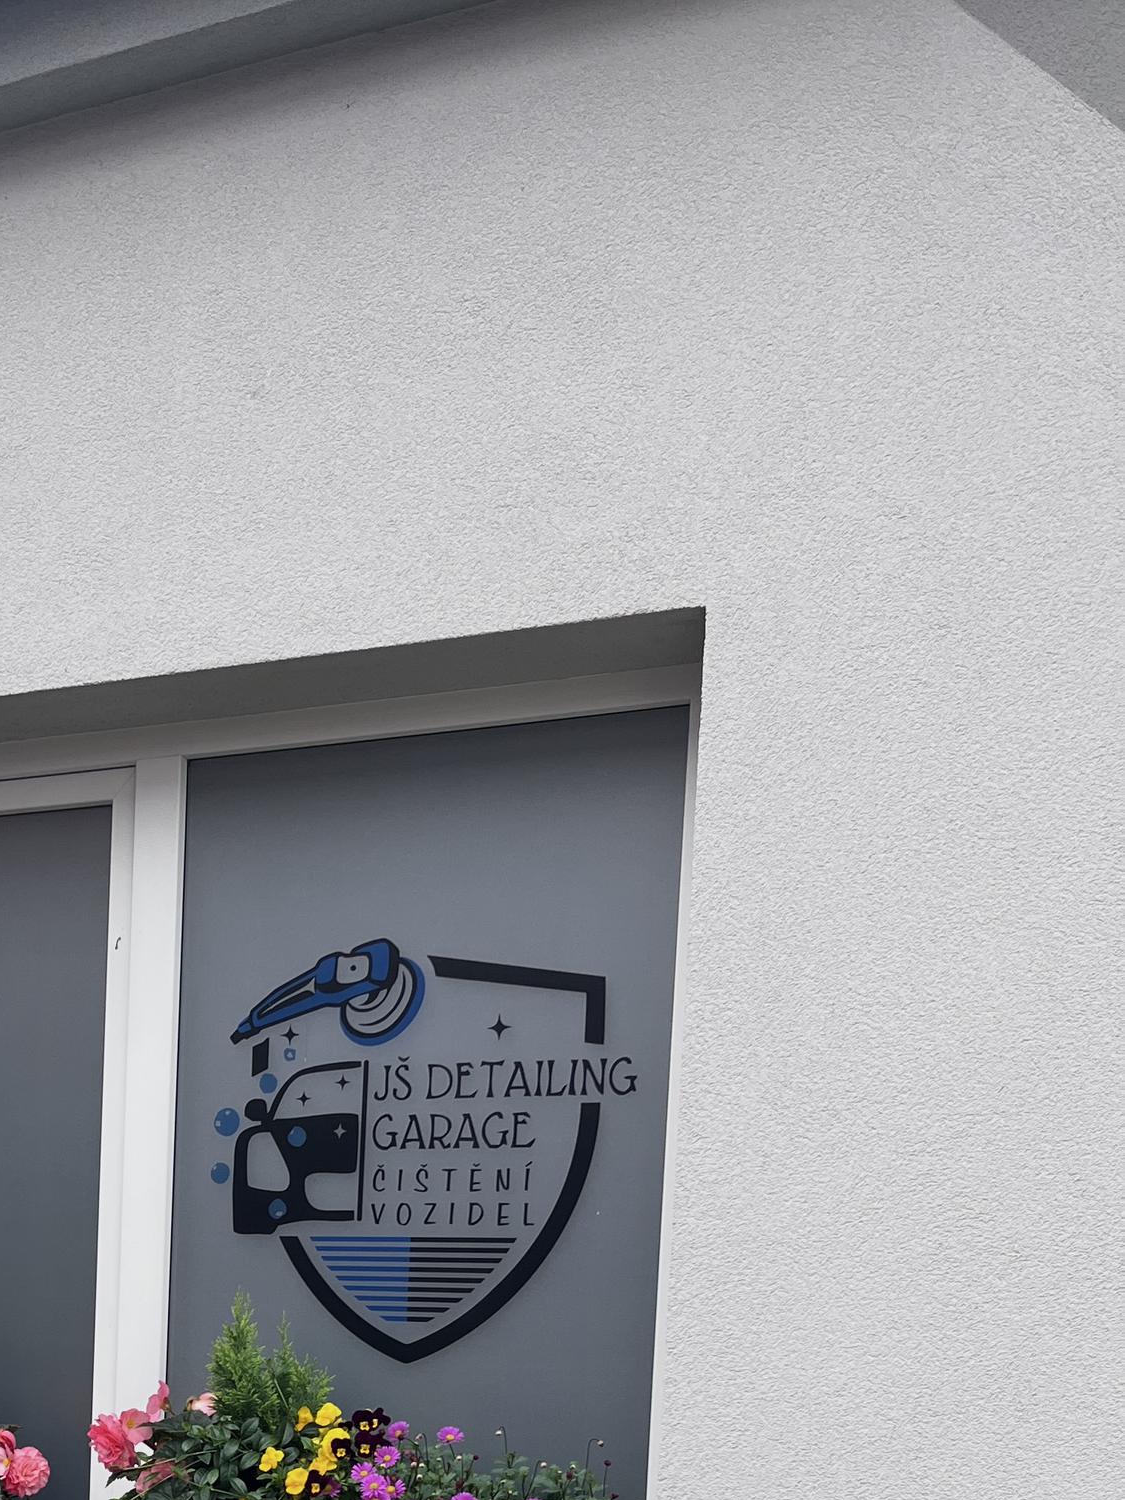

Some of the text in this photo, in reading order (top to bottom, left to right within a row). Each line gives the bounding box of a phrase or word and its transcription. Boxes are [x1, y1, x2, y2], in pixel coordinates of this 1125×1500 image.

[373, 1055, 638, 1101] JŠ DETAILING
[371, 1111, 536, 1150] GARAGE
[372, 1160, 533, 1193] ČIŠTĚNÍ
[371, 1202, 535, 1226] VOZIDEL
